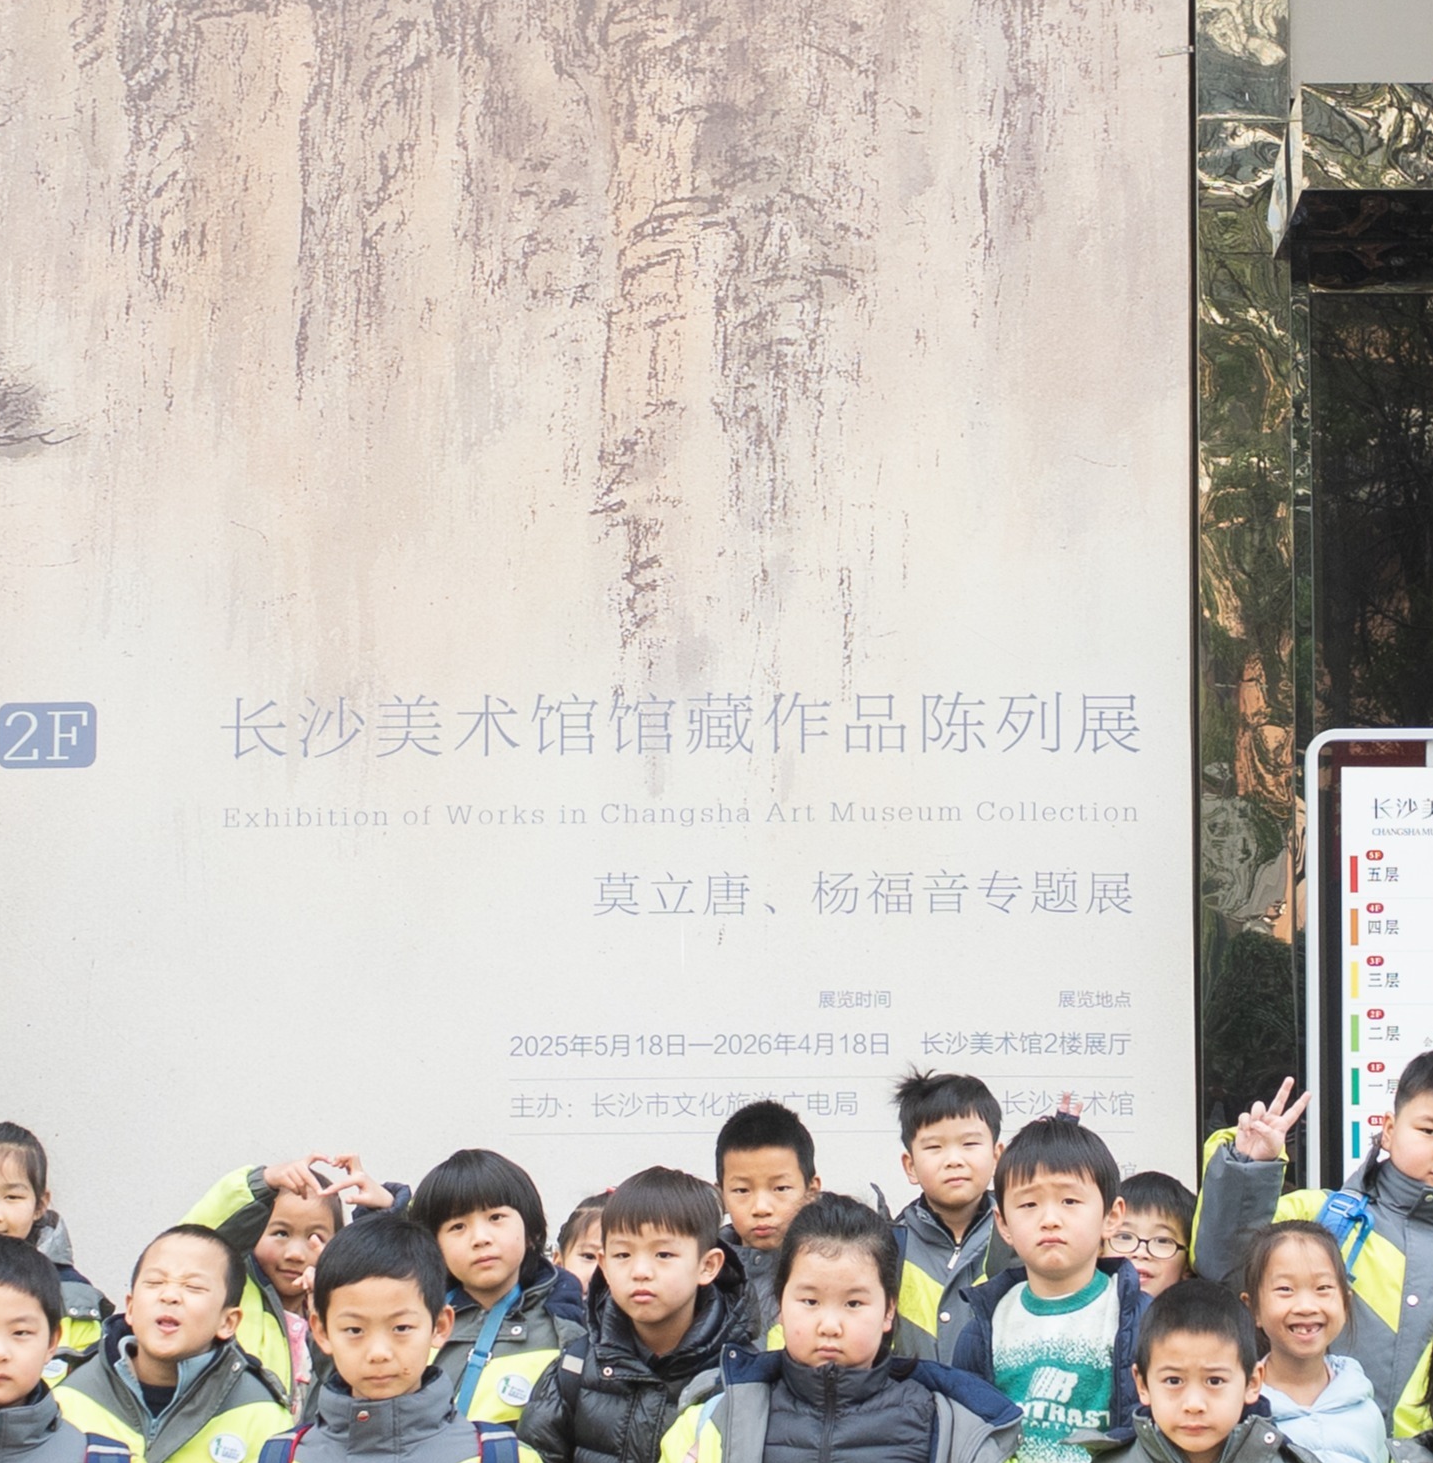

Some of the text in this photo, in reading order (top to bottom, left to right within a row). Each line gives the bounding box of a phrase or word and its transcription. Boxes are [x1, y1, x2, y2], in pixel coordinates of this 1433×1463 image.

[2, 710, 88, 761] 2F
[220, 692, 1141, 760] 长沙美术馆馆藏作品陈列展
[222, 799, 1139, 829] Exhibition of Works in Changsha Art Museum Collection
[1371, 827, 1420, 837] CHANGSHA
[1367, 867, 1399, 883] 五层
[592, 869, 1135, 917] 莫立唐、杨福音专题展
[1368, 919, 1400, 935] 四层
[1368, 972, 1400, 988] 三层
[817, 989, 1132, 1010] 展览时间 展览地点
[920, 1031, 1132, 1057] 长沙美术馆2楼展厅
[1368, 1026, 1400, 1042] 二层
